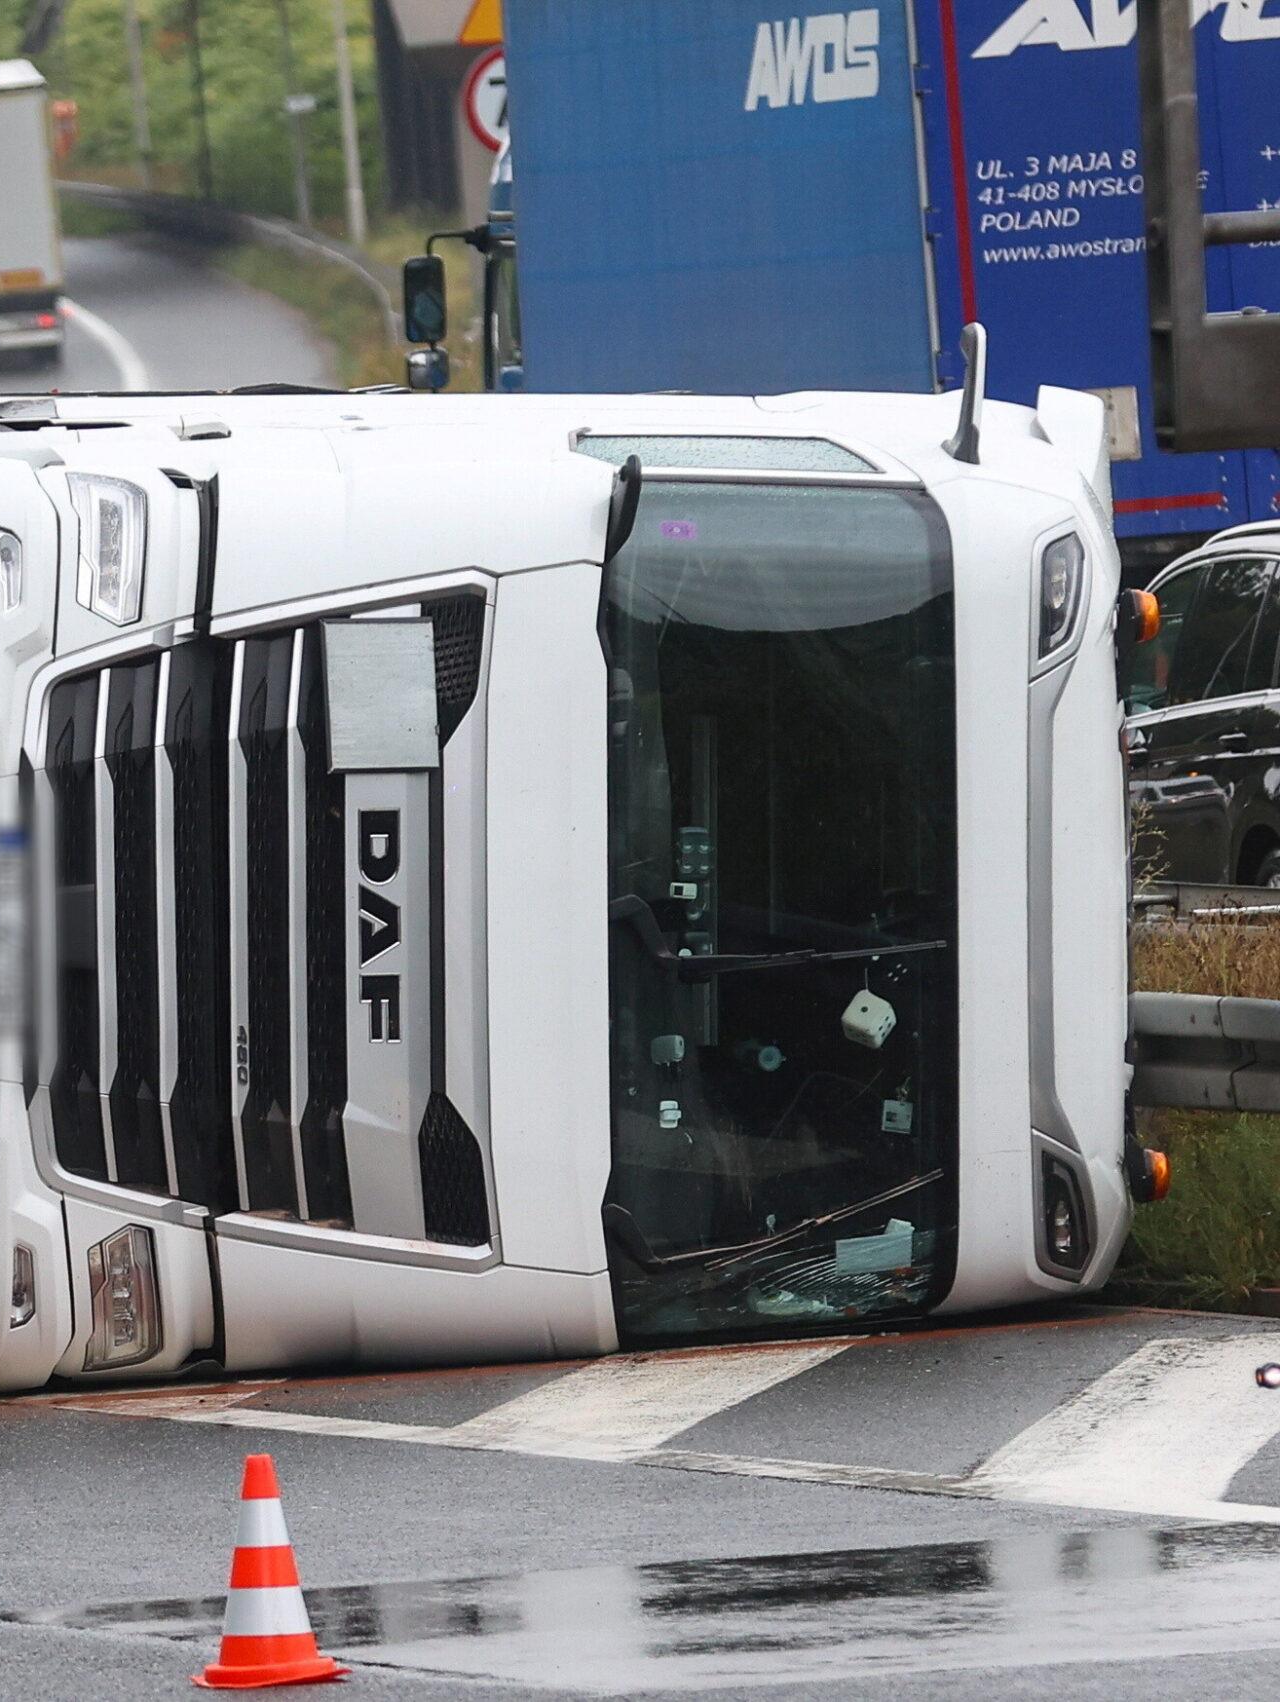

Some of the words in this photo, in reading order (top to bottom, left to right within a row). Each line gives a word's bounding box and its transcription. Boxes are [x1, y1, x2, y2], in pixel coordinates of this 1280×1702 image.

[744, 8, 880, 111] AWOS
[976, 159, 1015, 180] UL.
[1024, 156, 1040, 178] 3
[1047, 151, 1112, 175] MAJA
[1120, 149, 1137, 169] 8
[977, 180, 1060, 206] 41-408
[980, 207, 1081, 233] POLAND
[358, 808, 402, 1043] DAF
